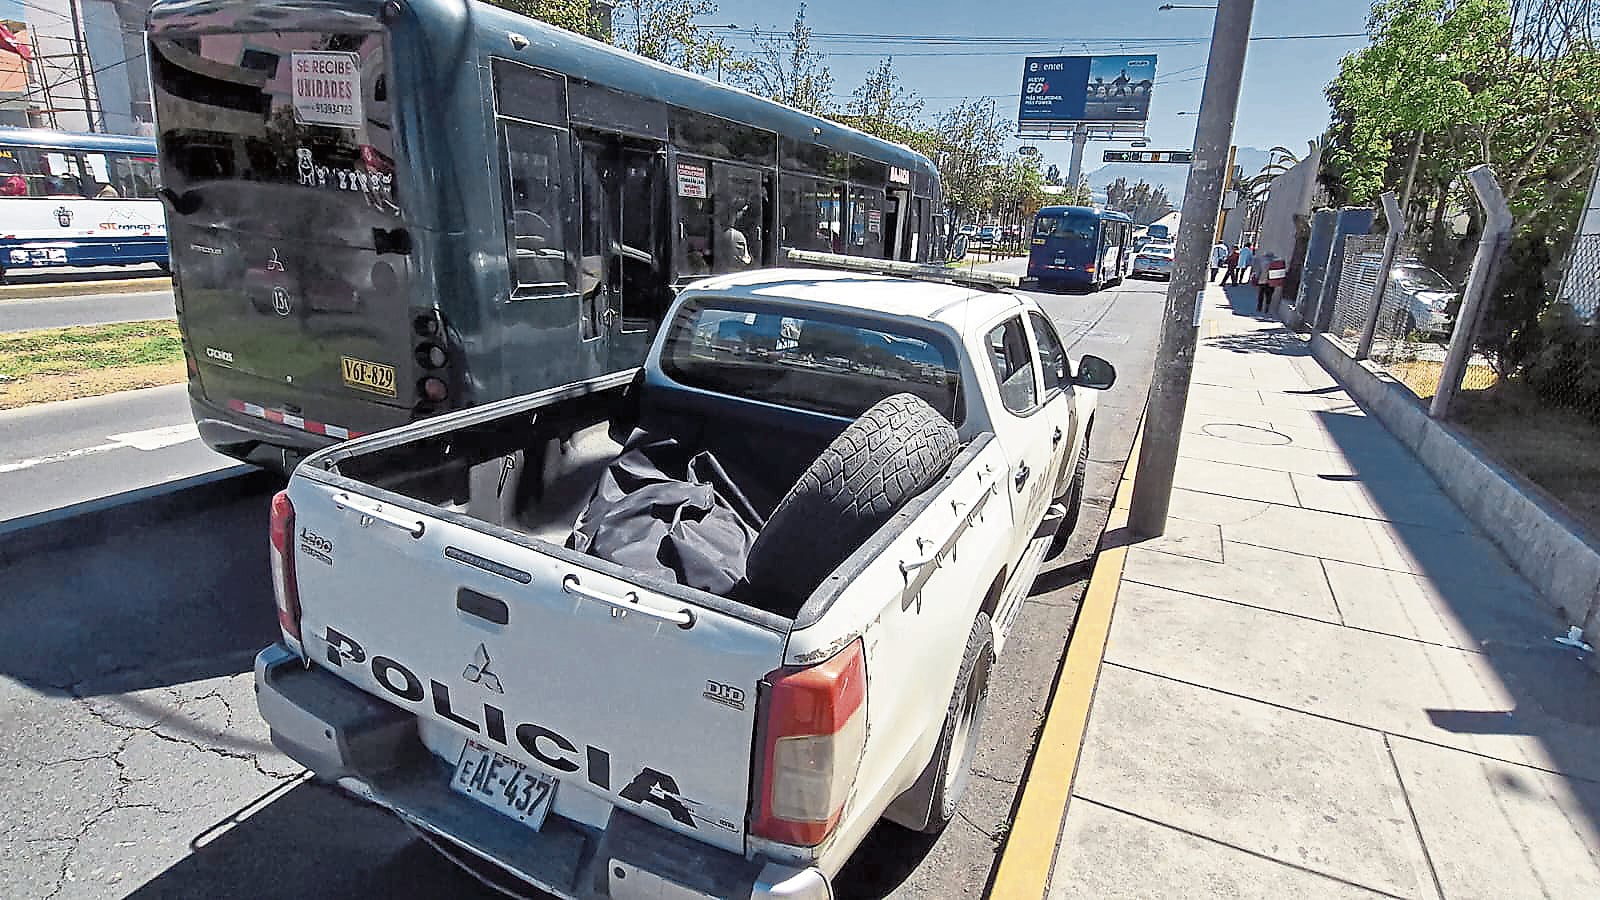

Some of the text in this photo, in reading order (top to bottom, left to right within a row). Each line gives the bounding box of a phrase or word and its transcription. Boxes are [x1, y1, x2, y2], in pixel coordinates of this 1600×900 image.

[296, 59, 352, 75] SE RECIBE
[1043, 62, 1064, 71] entel
[297, 79, 352, 99] UNIDADES
[345, 359, 393, 388] V6F-829
[326, 625, 698, 830] POLICIA
